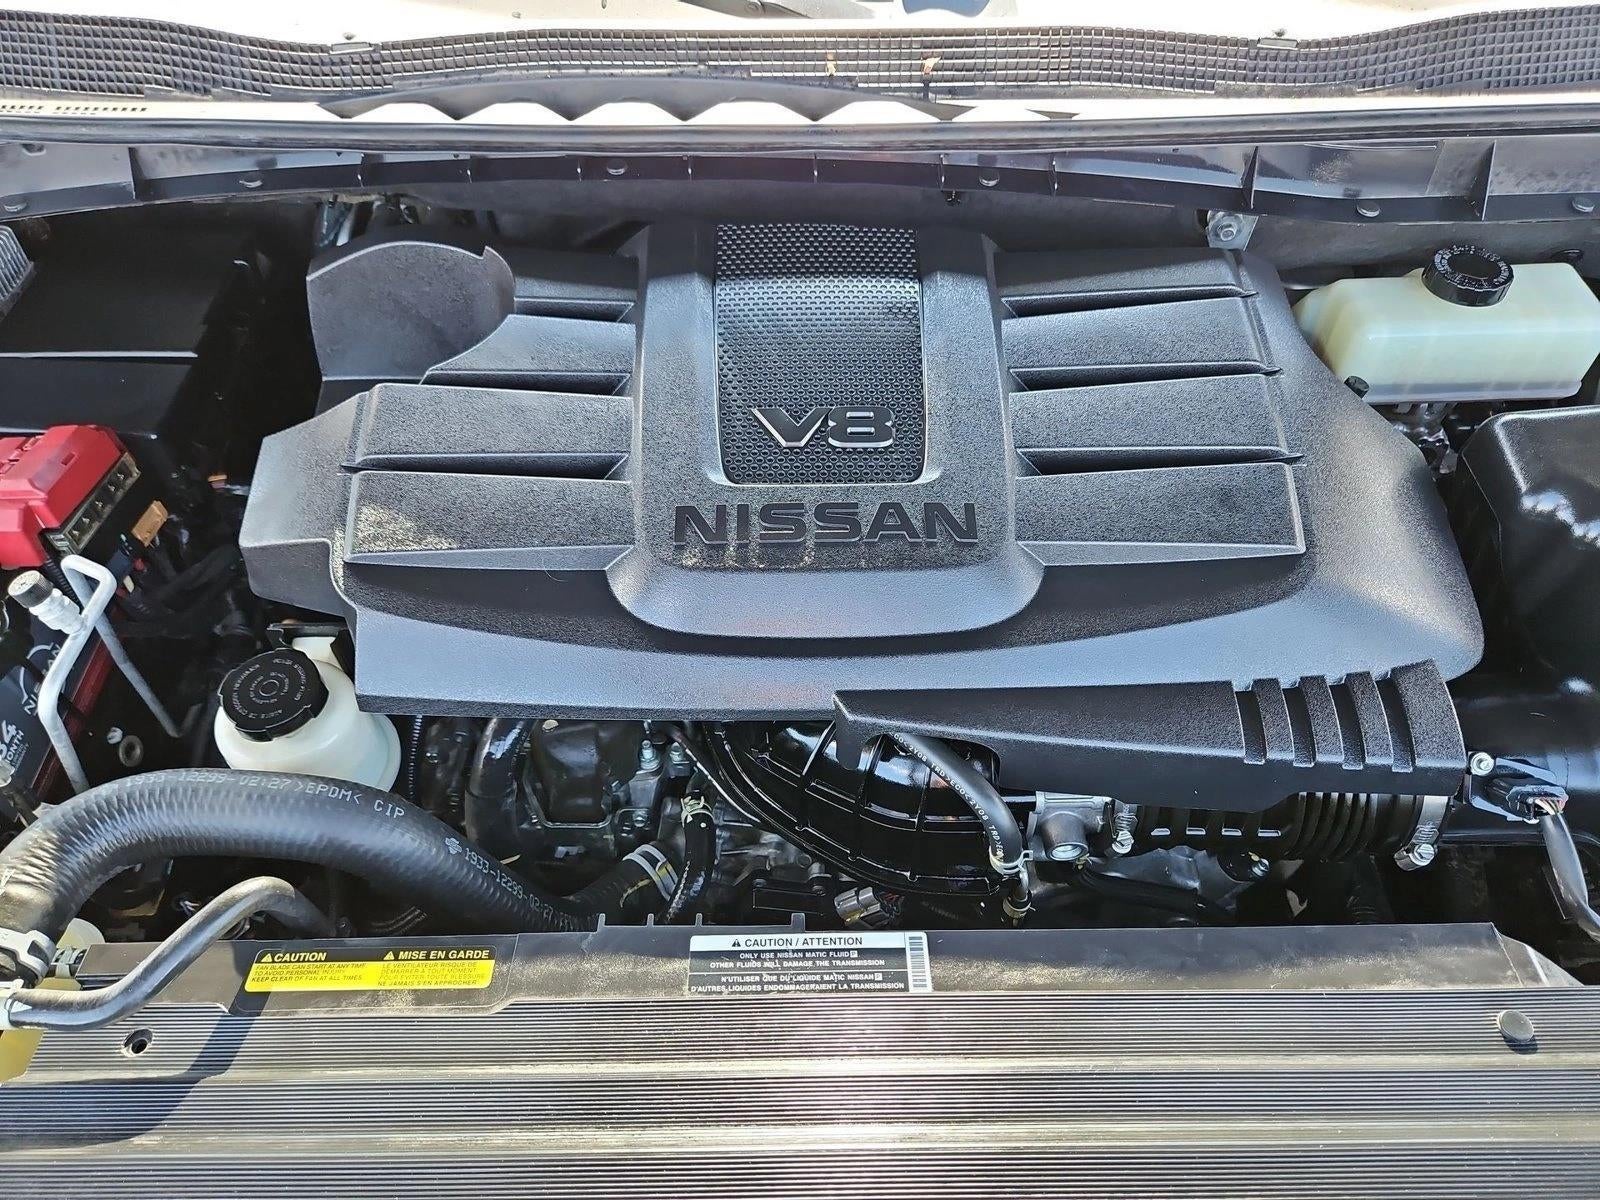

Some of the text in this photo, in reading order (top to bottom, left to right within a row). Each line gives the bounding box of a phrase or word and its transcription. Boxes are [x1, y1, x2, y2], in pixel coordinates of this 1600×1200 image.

[750, 406, 896, 448] V8
[672, 501, 979, 545] NISSAN
[373, 798, 406, 820] CIP
[744, 938, 793, 948] CAUTION
[802, 937, 863, 946] ATTENTION
[274, 952, 327, 962] CAUTION
[398, 950, 490, 960] MISE EN GARDE
[850, 982, 905, 990] TRANSMISSION
